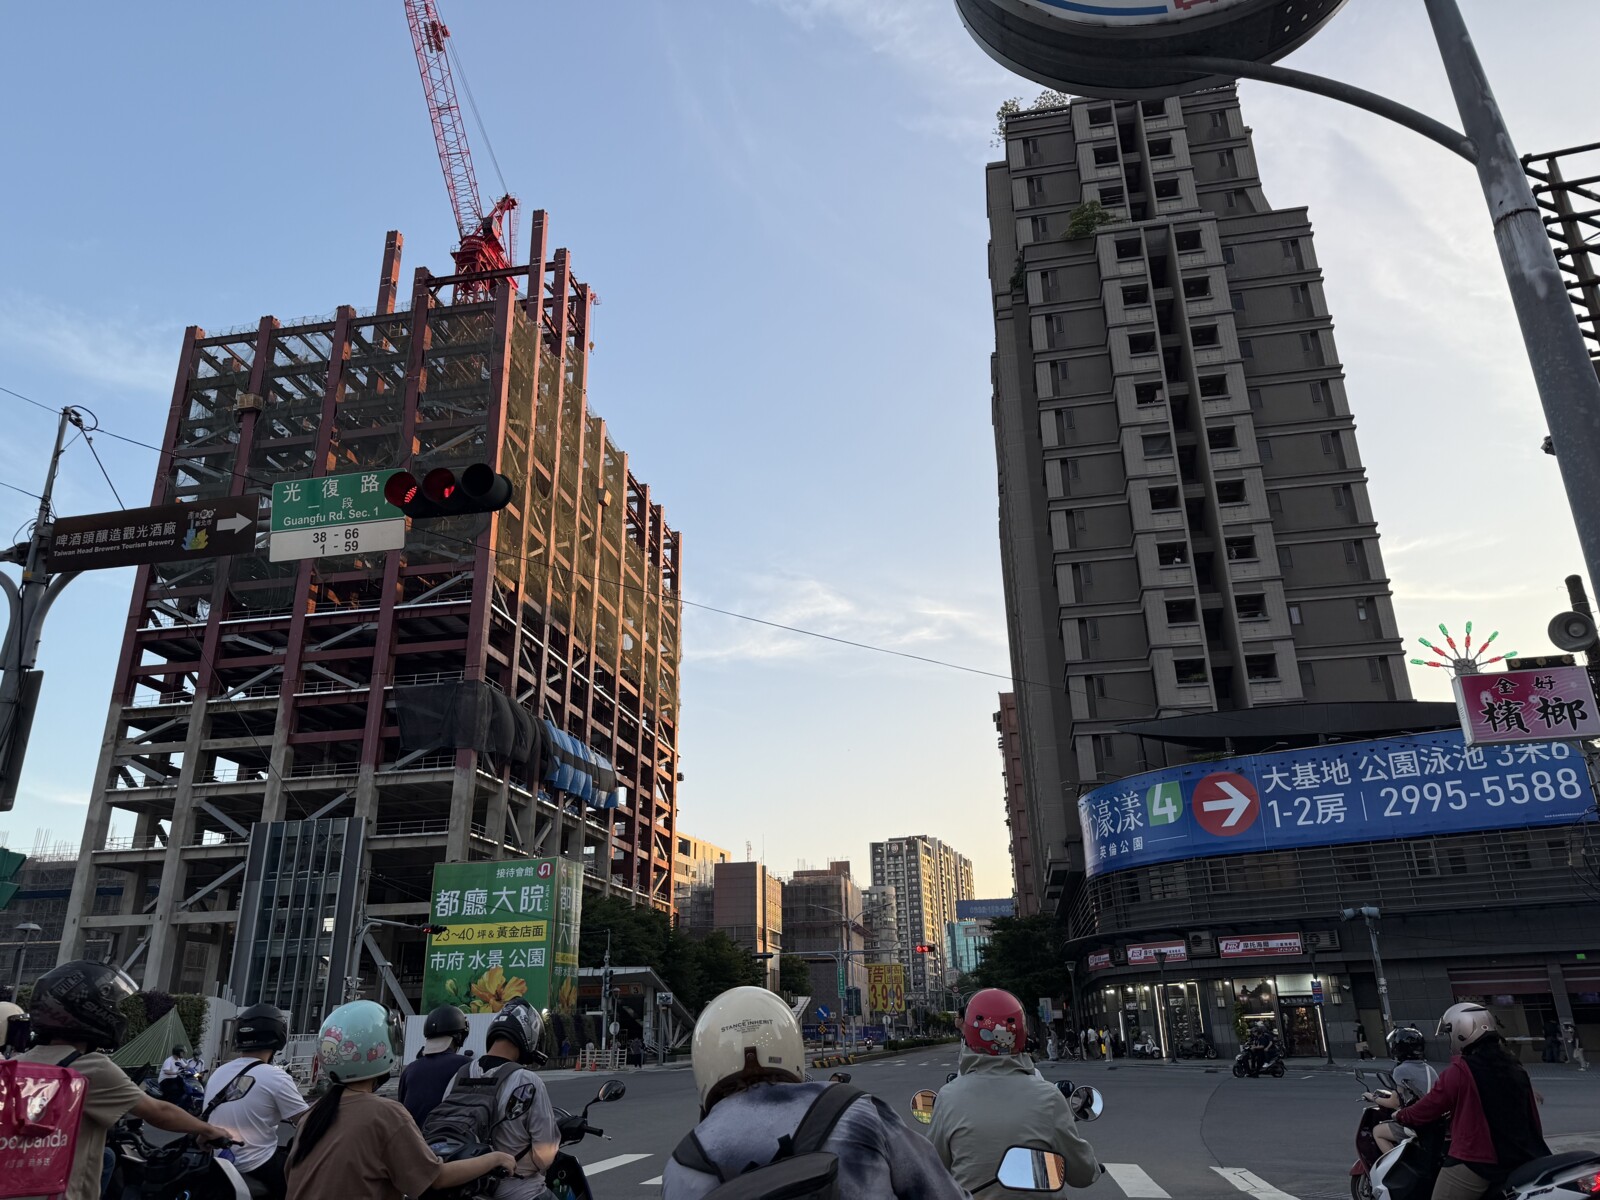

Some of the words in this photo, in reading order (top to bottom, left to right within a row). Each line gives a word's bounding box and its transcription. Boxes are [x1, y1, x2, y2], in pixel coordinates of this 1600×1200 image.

[283, 474, 380, 503] 光復路
[308, 497, 354, 509] 一段
[284, 514, 326, 527] Guangfu
[328, 511, 346, 521] Rd.
[348, 508, 371, 519] Sec.
[374, 506, 379, 516] 1
[56, 522, 177, 547] 啤酒頭釀造觀光酒廠
[312, 532, 327, 544] 38
[344, 528, 360, 540] 66
[54, 549, 76, 557] Taiwan
[76, 547, 94, 555] Head
[94, 544, 120, 553] Brewers
[122, 542, 146, 550] Tourism
[148, 538, 175, 548] Brewery
[320, 544, 326, 554] 1
[344, 540, 359, 552] 59
[1493, 676, 1557, 694] 金好
[1480, 697, 1588, 733] 檳榔
[1262, 758, 1352, 794] 大基地
[1358, 744, 1488, 782] 公園泳池
[1152, 784, 1178, 824] 4
[1268, 792, 1348, 828] 1-2房
[1380, 768, 1582, 817] 2995-5588
[1100, 836, 1143, 859] 英倫公園
[496, 866, 534, 879] 接待會館
[436, 884, 545, 917] 都廳大院
[476, 930, 487, 940] 坪
[497, 924, 544, 939] 黃金店面
[430, 951, 465, 972] 市府
[468, 949, 505, 970] 水景
[508, 948, 546, 968] 公園
[721, 1020, 746, 1032] STANCE
